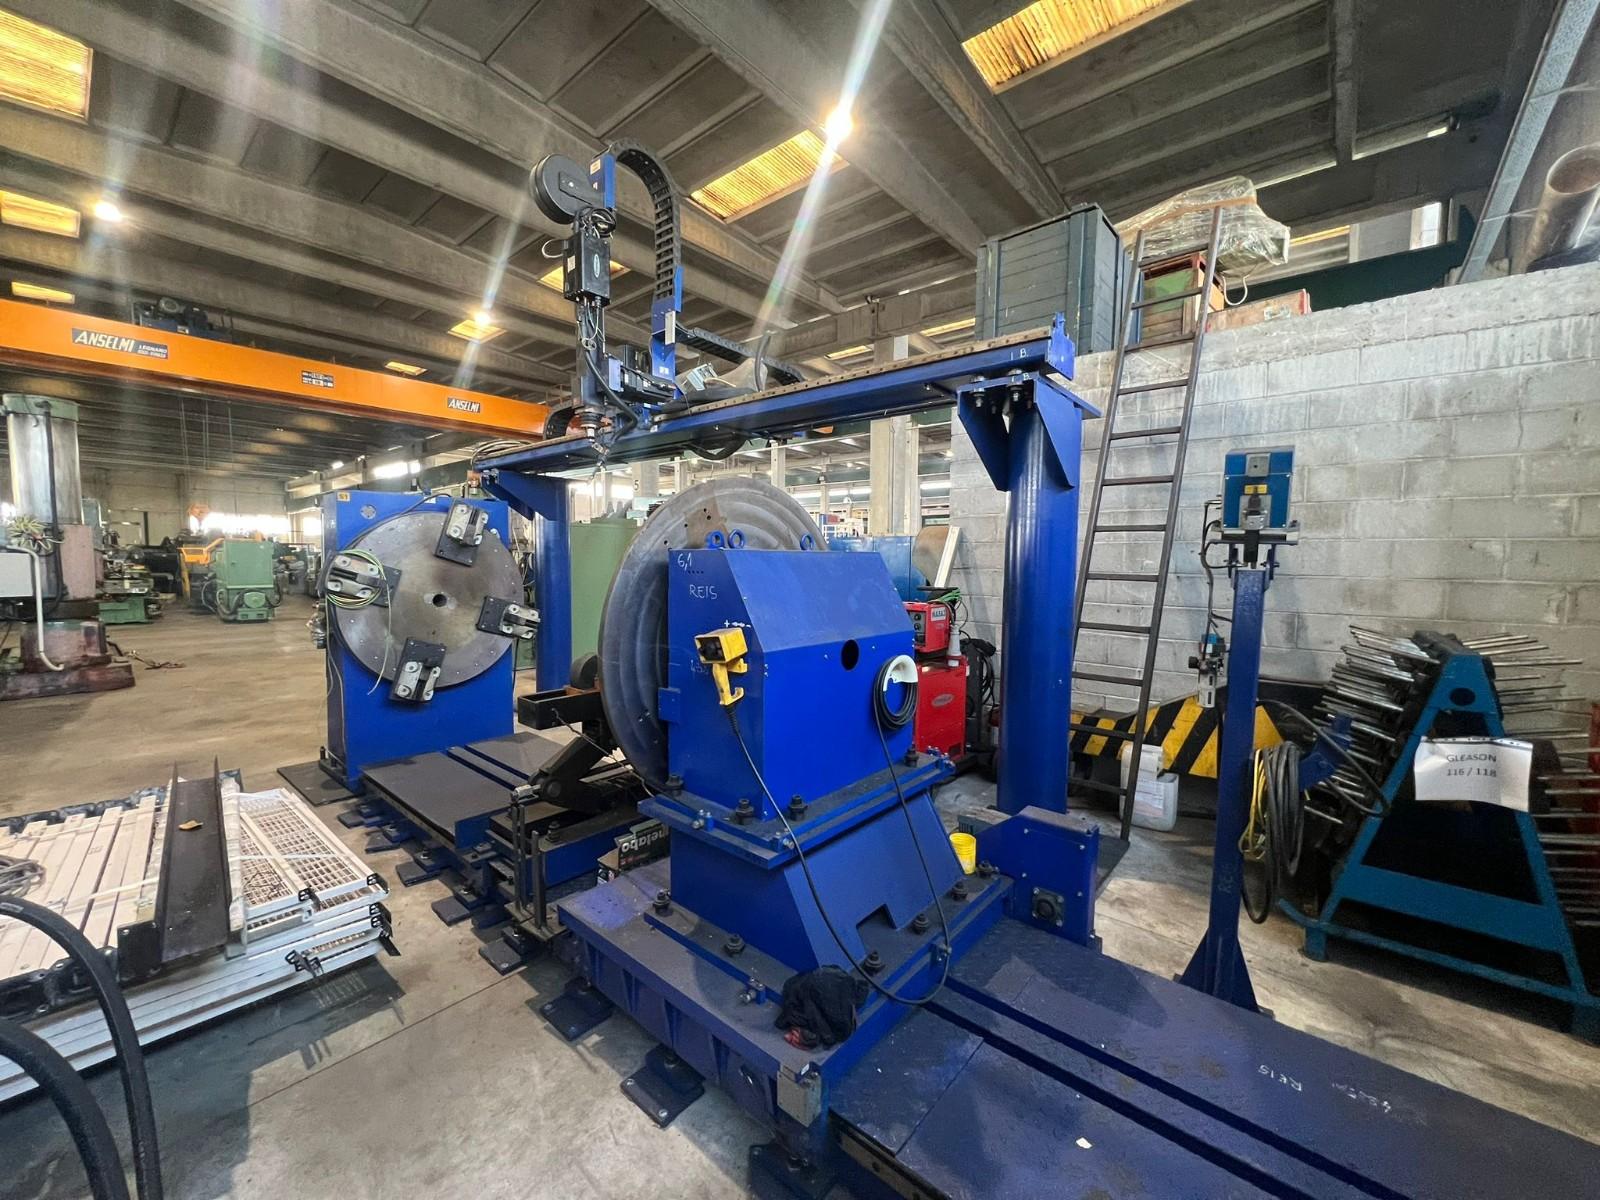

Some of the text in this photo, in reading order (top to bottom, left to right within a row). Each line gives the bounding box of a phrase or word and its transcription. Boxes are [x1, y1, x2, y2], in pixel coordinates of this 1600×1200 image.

[75, 331, 136, 353] ANSELMI
[448, 399, 480, 412] ANSELMI
[634, 479, 640, 491] 5
[689, 584, 718, 600] REIS
[1446, 753, 1497, 763] GLEASON
[1446, 768, 1465, 777] 116
[1476, 767, 1497, 778] 118
[1258, 1064, 1303, 1092] REIS
